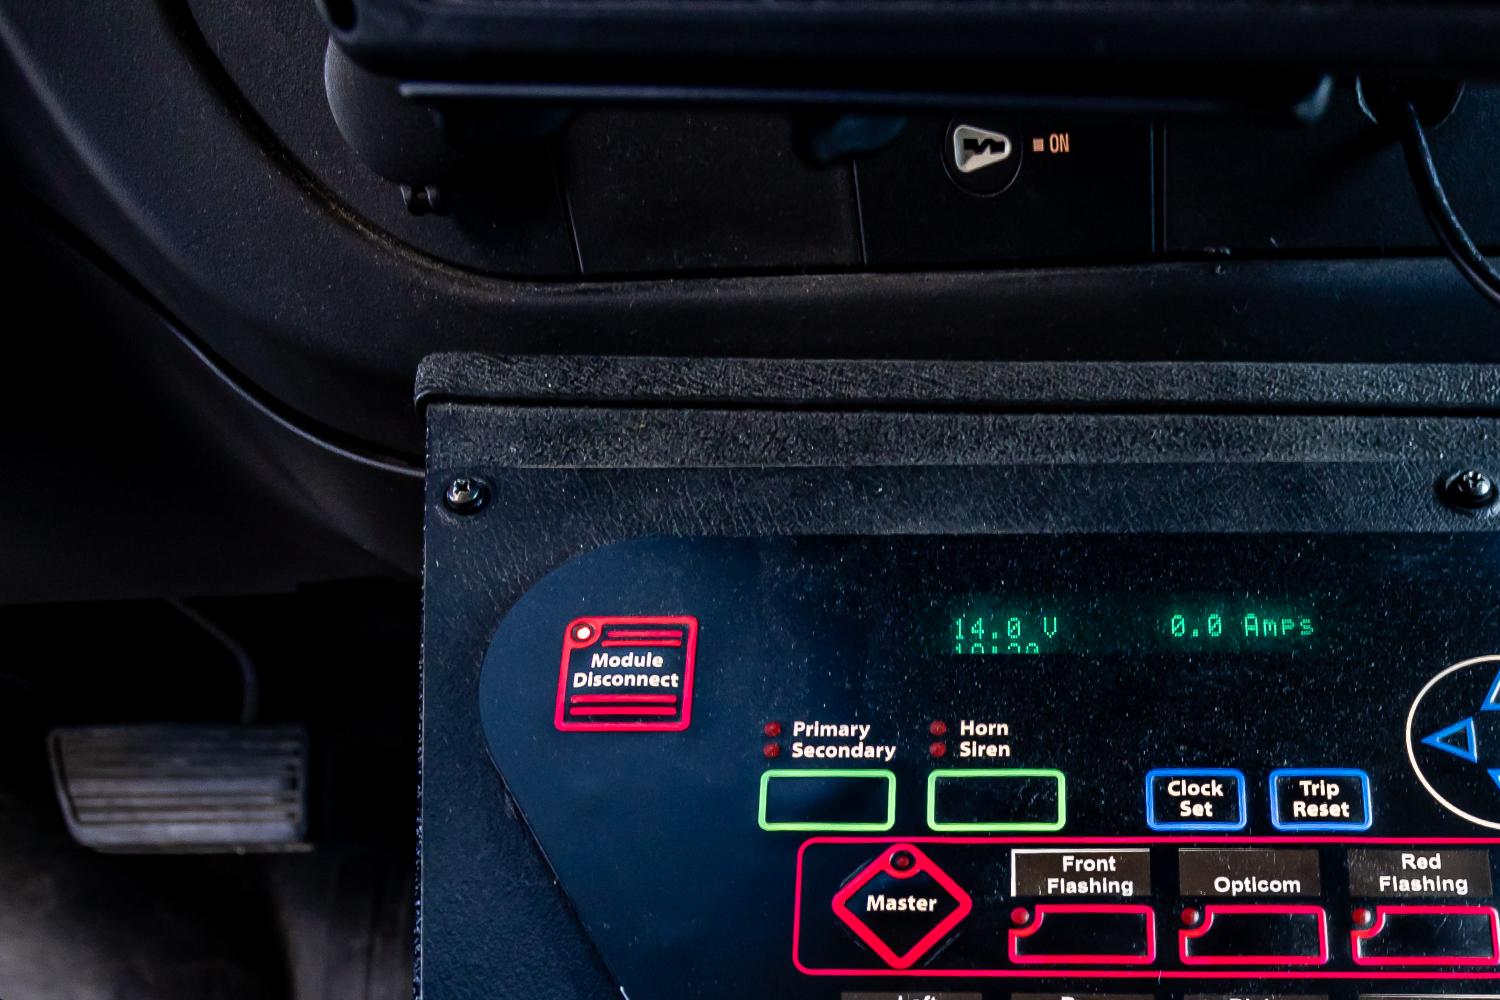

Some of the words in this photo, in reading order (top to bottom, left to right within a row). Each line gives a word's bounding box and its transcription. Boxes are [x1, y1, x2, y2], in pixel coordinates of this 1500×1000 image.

[1048, 132, 1071, 155] ON
[955, 617, 1021, 640] 14.0
[1043, 616, 1057, 639] V
[1171, 614, 1223, 637] 0.0
[1244, 612, 1314, 637] Amps
[591, 652, 664, 670] Module
[572, 671, 680, 689] Disconnect
[792, 721, 871, 741] Primary
[959, 720, 1010, 737] Horn
[791, 742, 897, 761] Secondary
[959, 741, 1011, 758] Siren
[1167, 779, 1224, 798] Clock
[1299, 779, 1340, 800] Trip
[1179, 800, 1214, 818] Set
[1292, 801, 1350, 818] Reset
[1062, 855, 1117, 873] Front
[1401, 853, 1442, 871] Red
[1047, 876, 1134, 897] Flashing
[1214, 875, 1301, 894] Opticom
[1379, 874, 1469, 895] Flashing
[866, 894, 938, 912] Master
